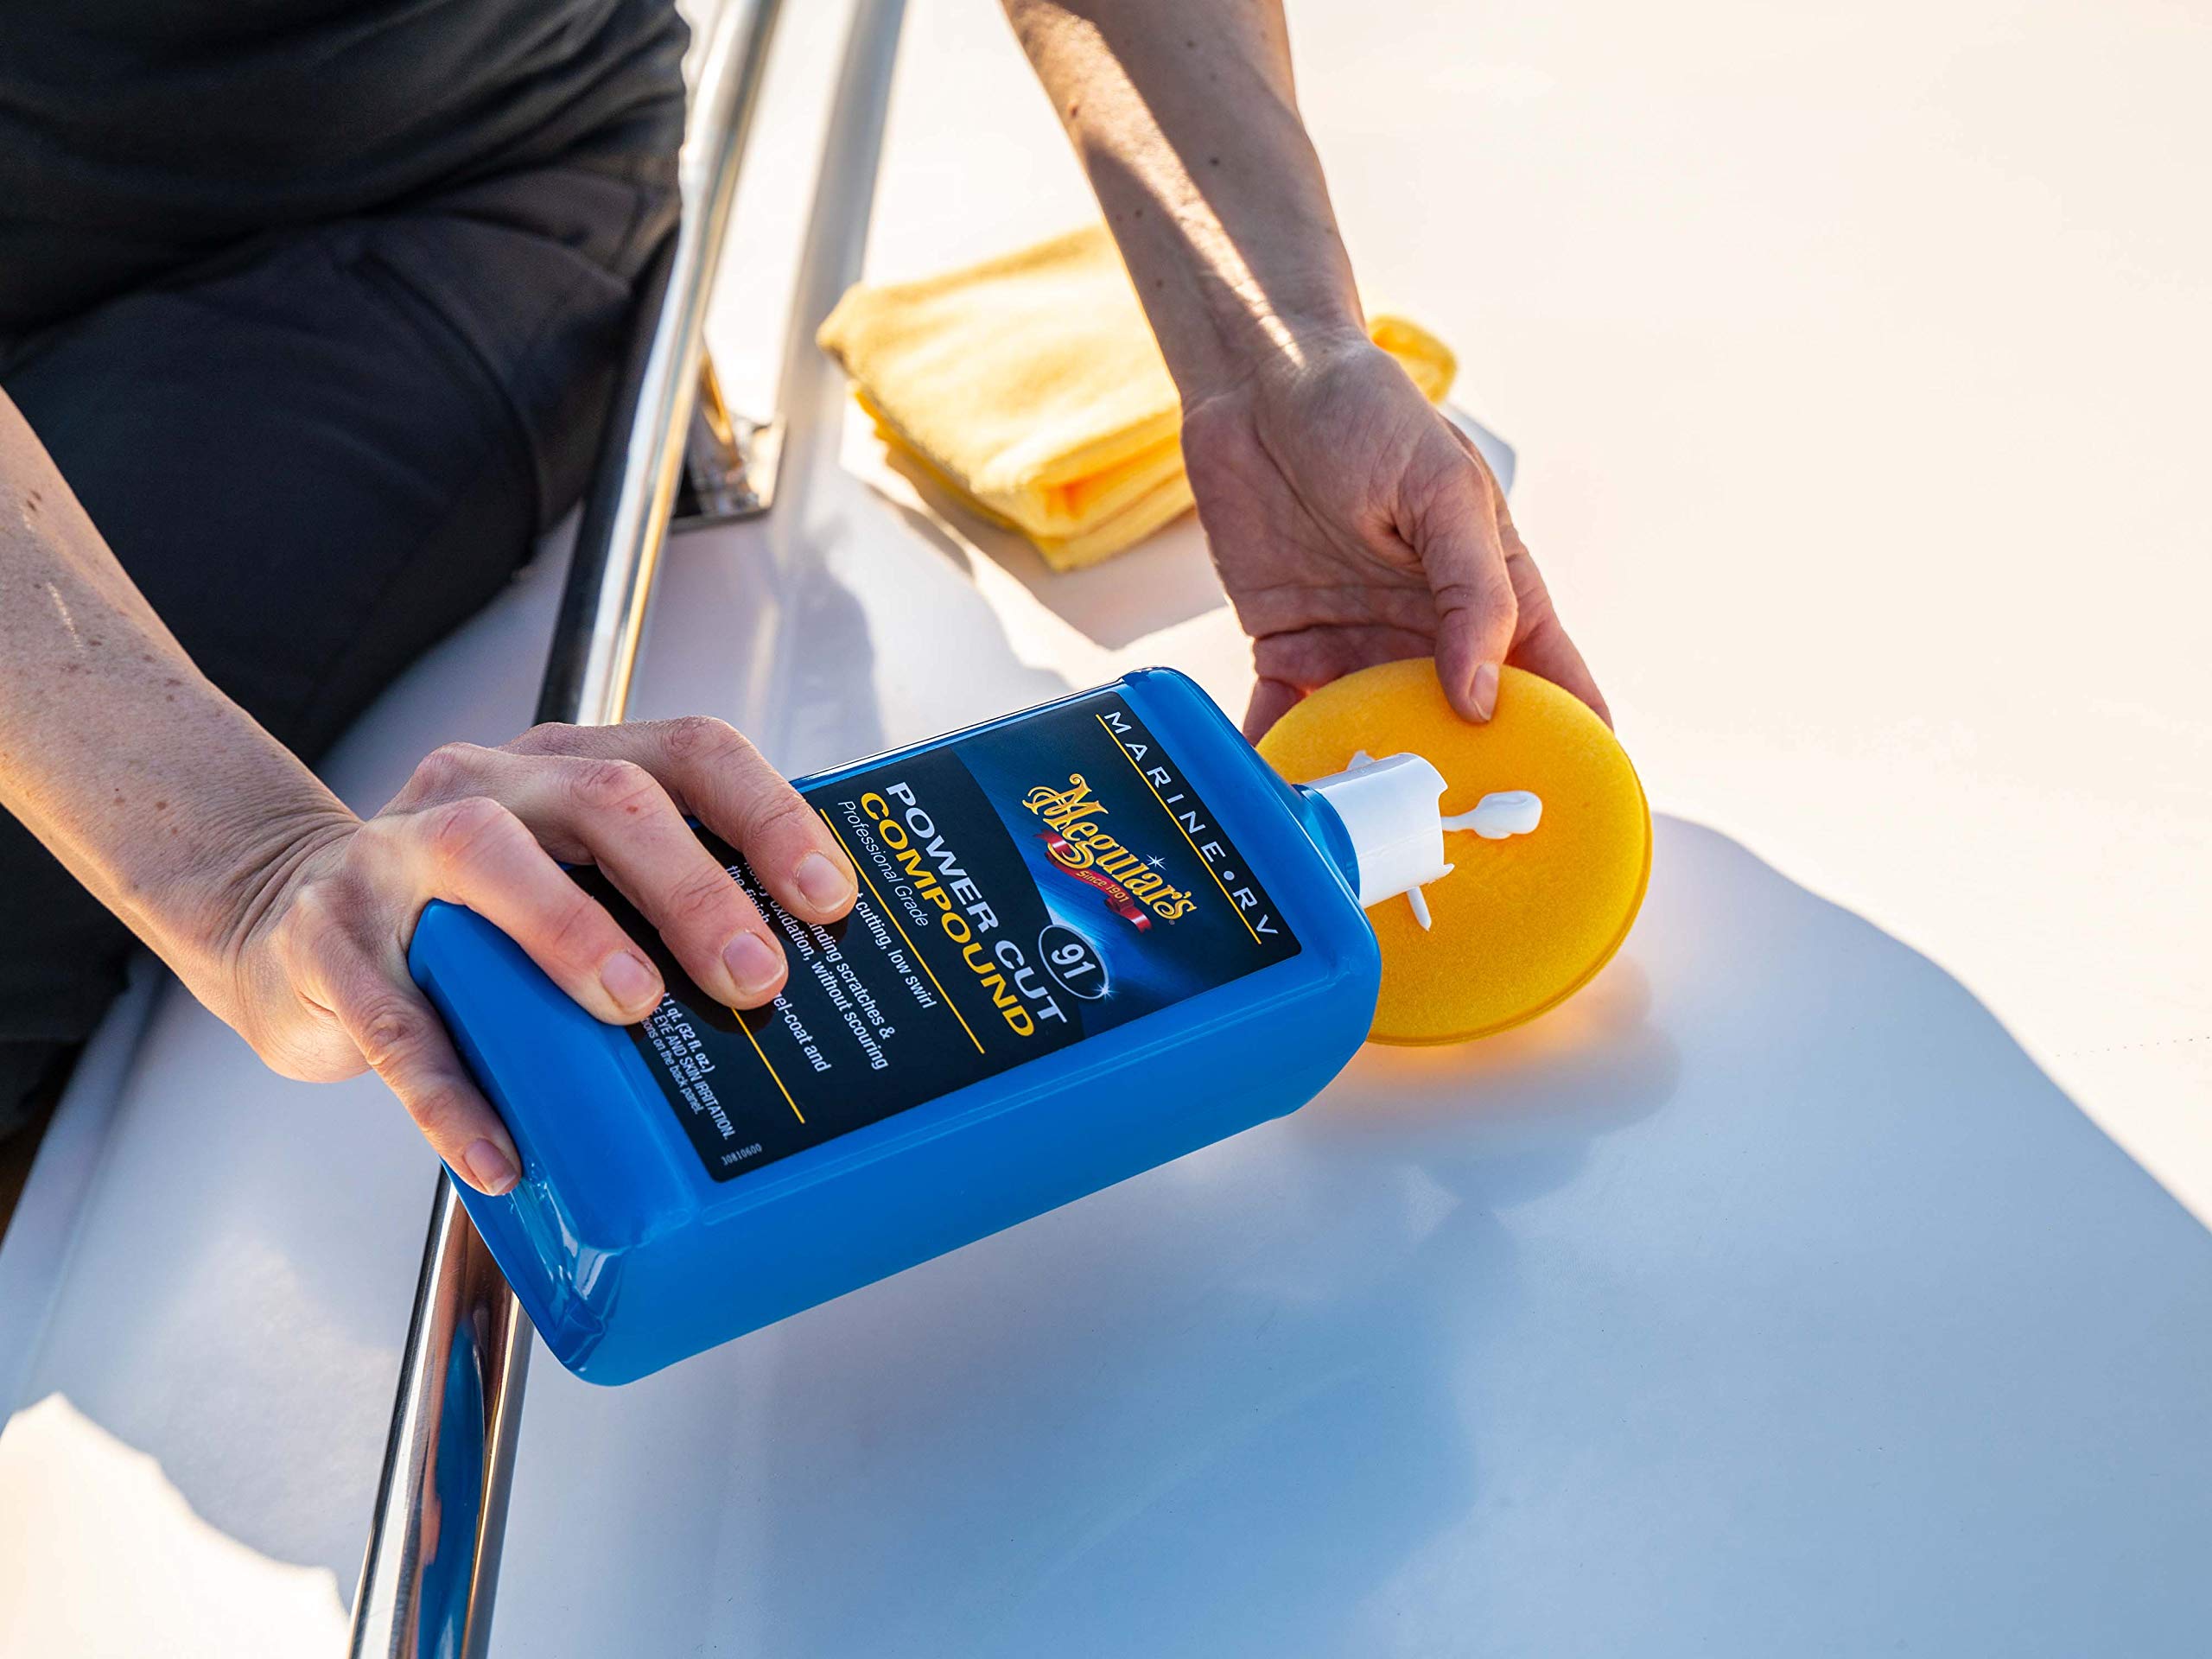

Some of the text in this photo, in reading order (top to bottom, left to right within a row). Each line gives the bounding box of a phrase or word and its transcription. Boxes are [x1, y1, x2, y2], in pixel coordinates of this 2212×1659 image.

[837, 800, 929, 927] Professional Grade
[1076, 870, 1129, 904] Since 1901
[861, 792, 1035, 1037] COMPOUND
[886, 782, 1067, 1023] POWER CUT
[855, 901, 938, 1008] cutting, low swirl
[1051, 944, 1096, 980] 91
[811, 961, 853, 1012] without
[843, 1011, 889, 1071] scouring
[836, 963, 885, 1027] scratches
[879, 1026, 895, 1040] &
[653, 1038, 665, 1051] on
[660, 1050, 675, 1065] the
[670, 1065, 688, 1088] back
[654, 1014, 674, 1035] EYE
[665, 1035, 687, 1057] AND
[679, 1056, 702, 1081] SKIN
[675, 1023, 696, 1040] (32
[695, 1052, 715, 1073] oz.)
[804, 1045, 831, 1072] and
